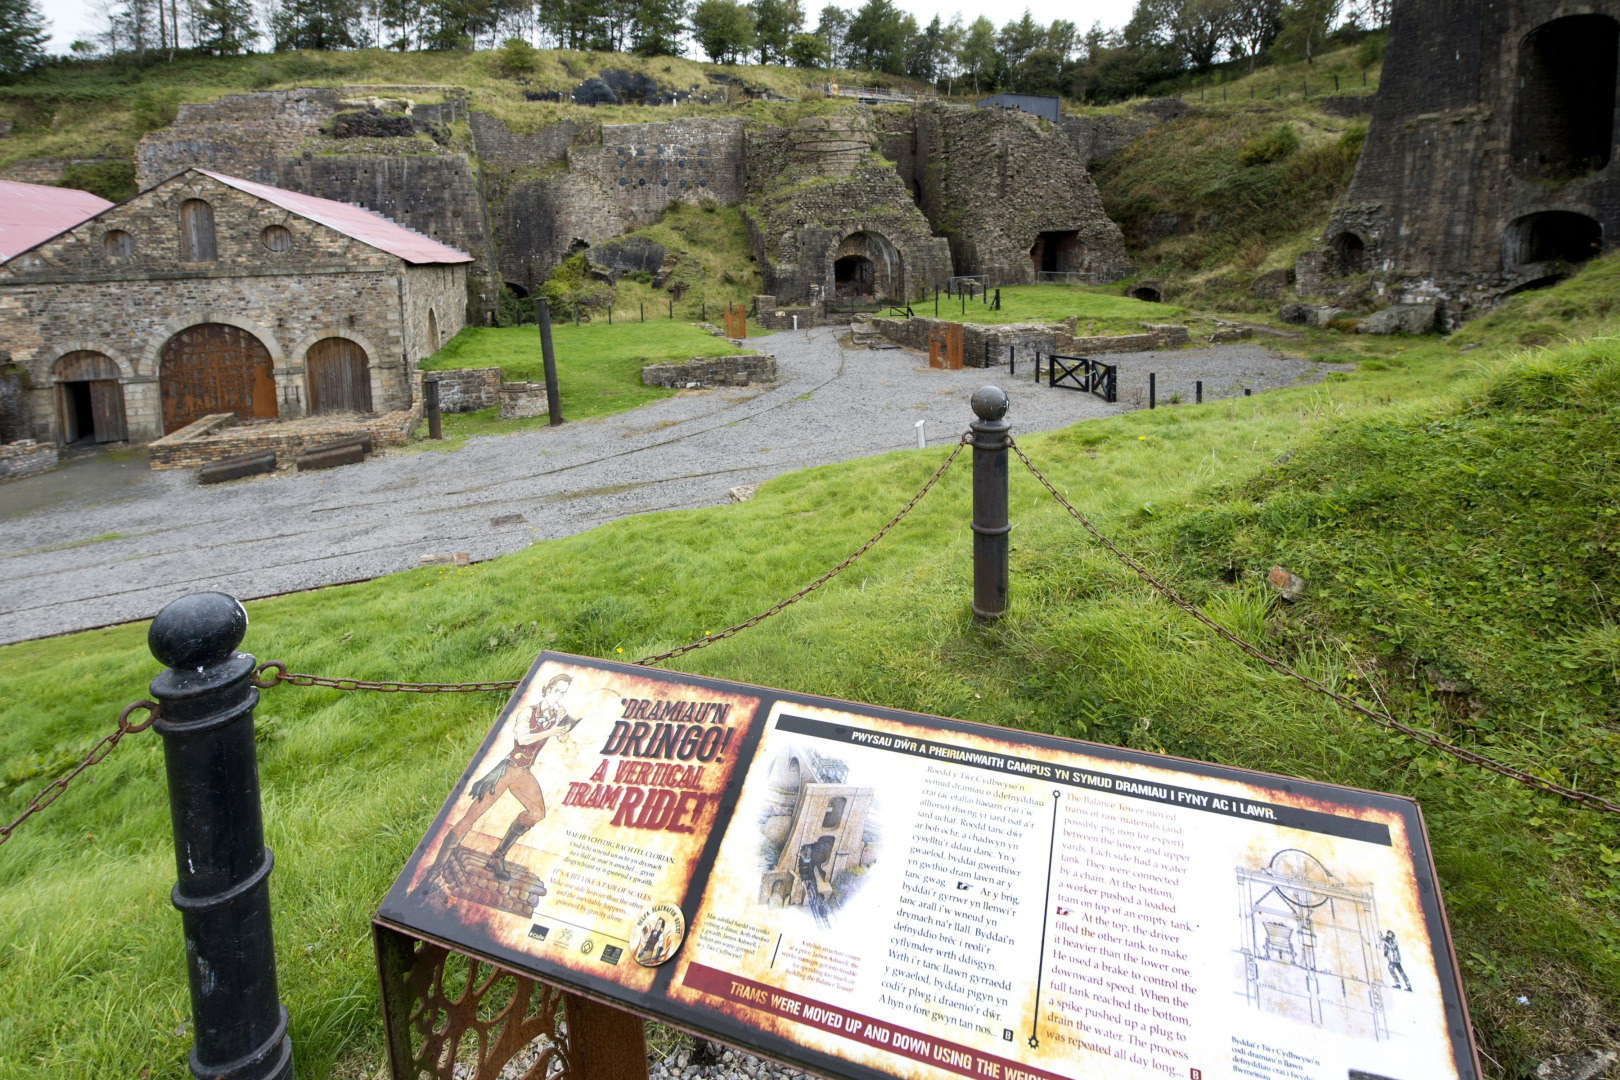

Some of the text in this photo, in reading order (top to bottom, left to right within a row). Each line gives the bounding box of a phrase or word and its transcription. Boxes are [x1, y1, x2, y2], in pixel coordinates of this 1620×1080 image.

[600, 720, 734, 763] DRINGO!
[589, 759, 705, 790] A VERTICAL
[852, 731, 1277, 820] PWYSAU DŴR A PHEIRIANWAITH CAMPUS YN SYMUD DRAMIAU I FYNY AC I LAWR.
[561, 782, 623, 811] TRAM
[902, 881, 1016, 916] byddai'r gyrrwr yn llenwi'r
[904, 869, 1020, 905] tanc gwag. Ar y brig,
[896, 907, 1014, 944] drymach na'r llall. Byddai'n
[899, 895, 997, 927] tanc arall i'w wneud yn
[1081, 912, 1179, 944] At the top, the driver
[890, 937, 996, 971] cyflymder wrth ddisgyn.
[893, 920, 990, 953] defnyddio brêc i reoli'r
[1054, 935, 1191, 978] it heavier than the lower one.
[1055, 920, 1187, 961] filled the other tank to make
[884, 965, 1007, 1007] y gwaelod, byddai pigyn yn
[887, 948, 1011, 990] Wrth i'r tanc llawn gyrraedd
[1051, 964, 1188, 1010] downward speed. When the
[1053, 949, 1066, 961] He
[1069, 956, 1090, 967] used
[1101, 962, 1128, 977] brake
[1131, 971, 1140, 981] to
[1143, 975, 1177, 990] control
[1181, 983, 1196, 995] the
[878, 993, 998, 1037] A hyn o fore gwyn tan nos...
[881, 980, 1001, 1021] codi'r plwg i draenio'r dŵr.
[1050, 979, 1191, 1028] full tank reached the bottom,
[1056, 1000, 1082, 1013] spike
[1085, 1008, 1120, 1024] pushed
[1124, 1019, 1137, 1032] up
[1149, 1025, 1173, 1042] plug
[1176, 1032, 1186, 1043] to
[730, 982, 768, 1005] TRAMS
[771, 994, 802, 1015] WERE
[803, 1004, 843, 1029] MOVED
[845, 1018, 862, 1034] UP
[864, 1024, 889, 1044] AND
[892, 1032, 930, 1057] DOWN
[933, 1045, 972, 1070] USING
[976, 1058, 1001, 1079] THE
[1047, 1011, 1188, 1061] drain the water. The process
[1045, 1030, 1185, 1079] was repeated all day long...
